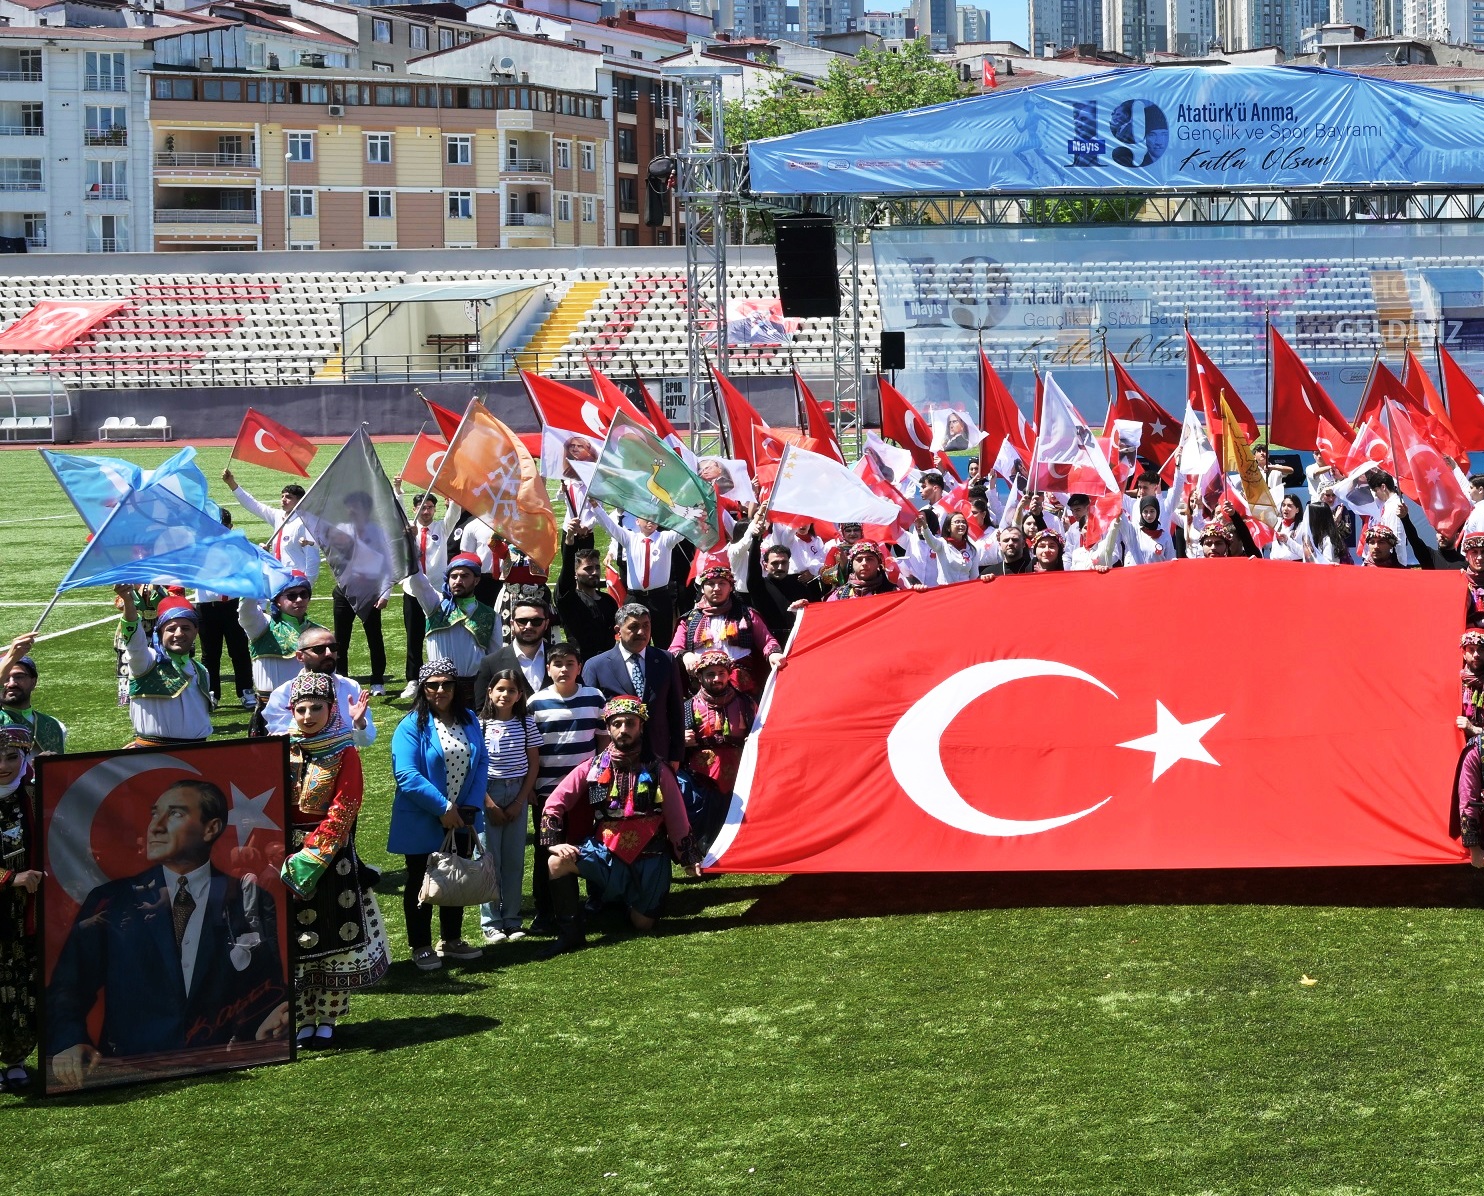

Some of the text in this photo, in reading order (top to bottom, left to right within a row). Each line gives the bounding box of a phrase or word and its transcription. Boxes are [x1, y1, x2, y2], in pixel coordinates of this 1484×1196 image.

[1251, 103, 1298, 124] Anma,
[1177, 123, 1382, 144] Gençlik ve Spor Bayramı
[1072, 140, 1100, 153] Mayıs
[1179, 146, 1334, 172] Kutlu Olsun
[910, 302, 943, 317] Mayıs
[1023, 311, 1080, 330] Gençlik
[1108, 311, 1144, 329] Spor
[665, 382, 683, 393] SPOR
[665, 395, 687, 406] CUYUZ
[665, 407, 677, 420] BİZ
